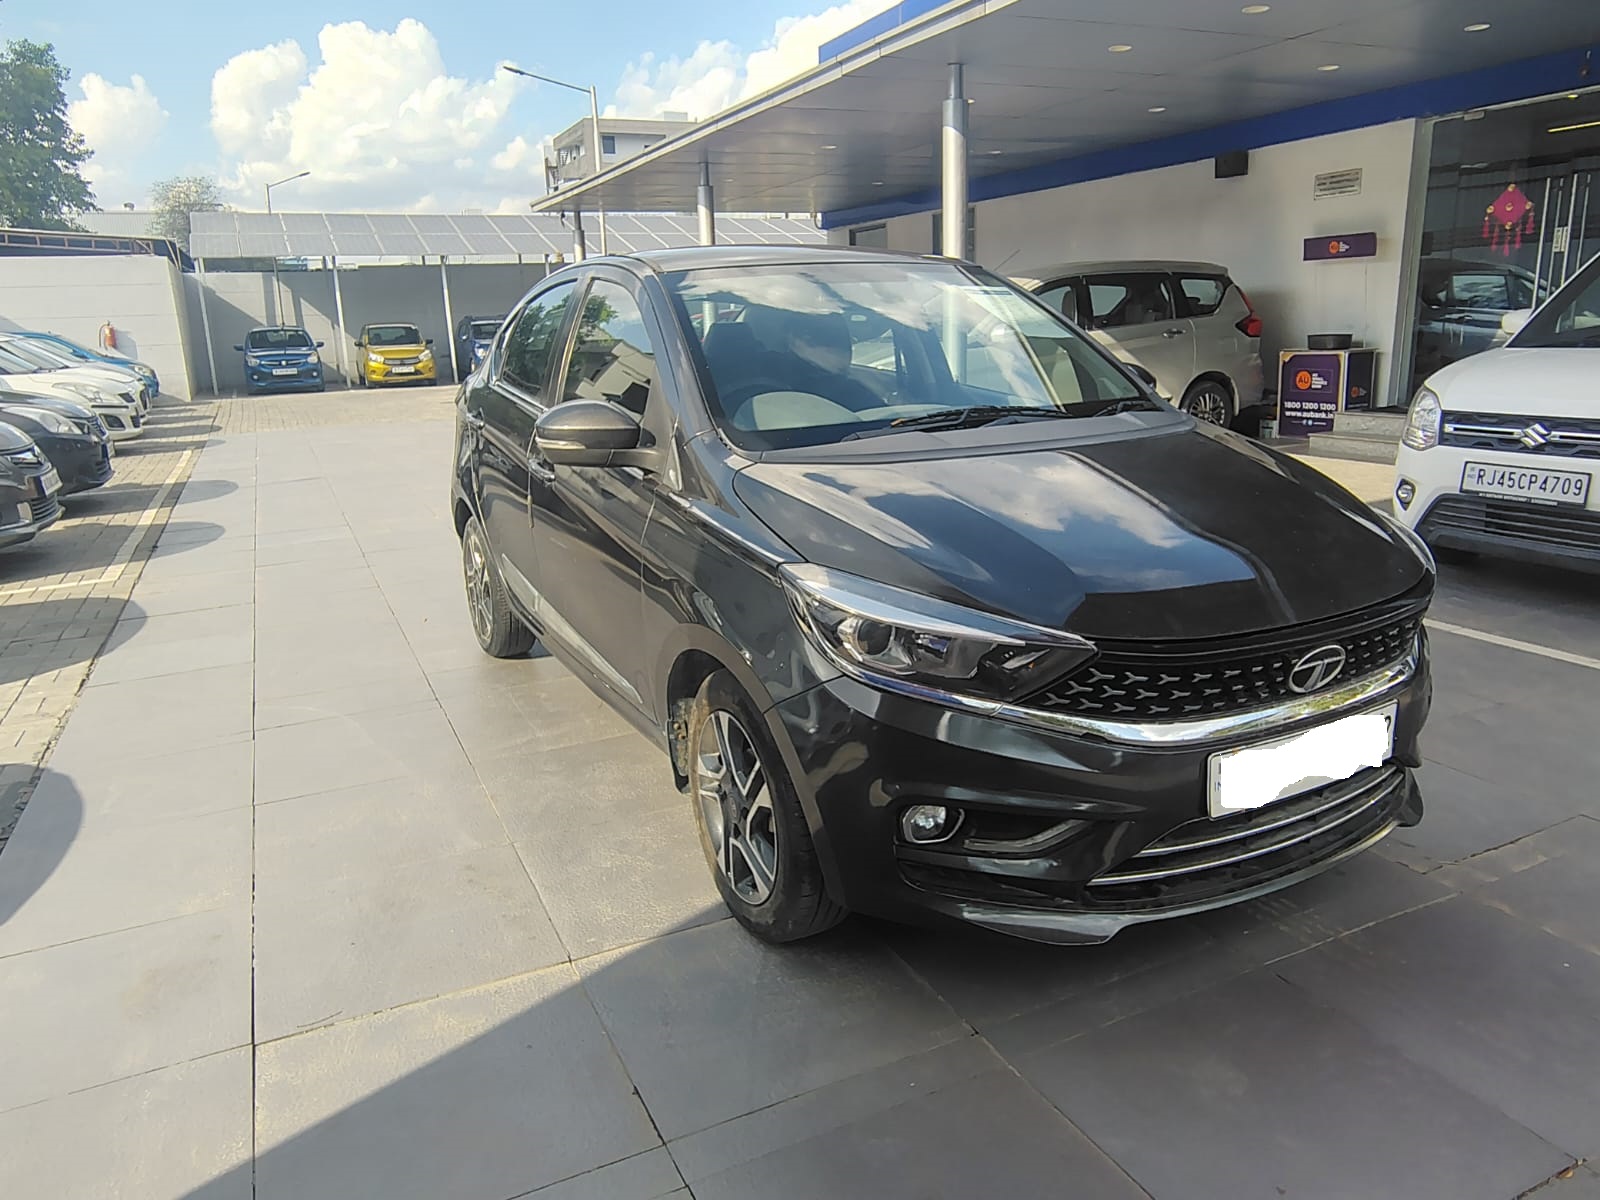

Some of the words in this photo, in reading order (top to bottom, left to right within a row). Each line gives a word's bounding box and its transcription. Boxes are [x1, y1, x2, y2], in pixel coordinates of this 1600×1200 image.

[1284, 401, 1301, 409] 1800
[1302, 402, 1319, 410] 1200
[1320, 403, 1336, 411] 1200
[1476, 468, 1583, 496] RJ45CP4709
